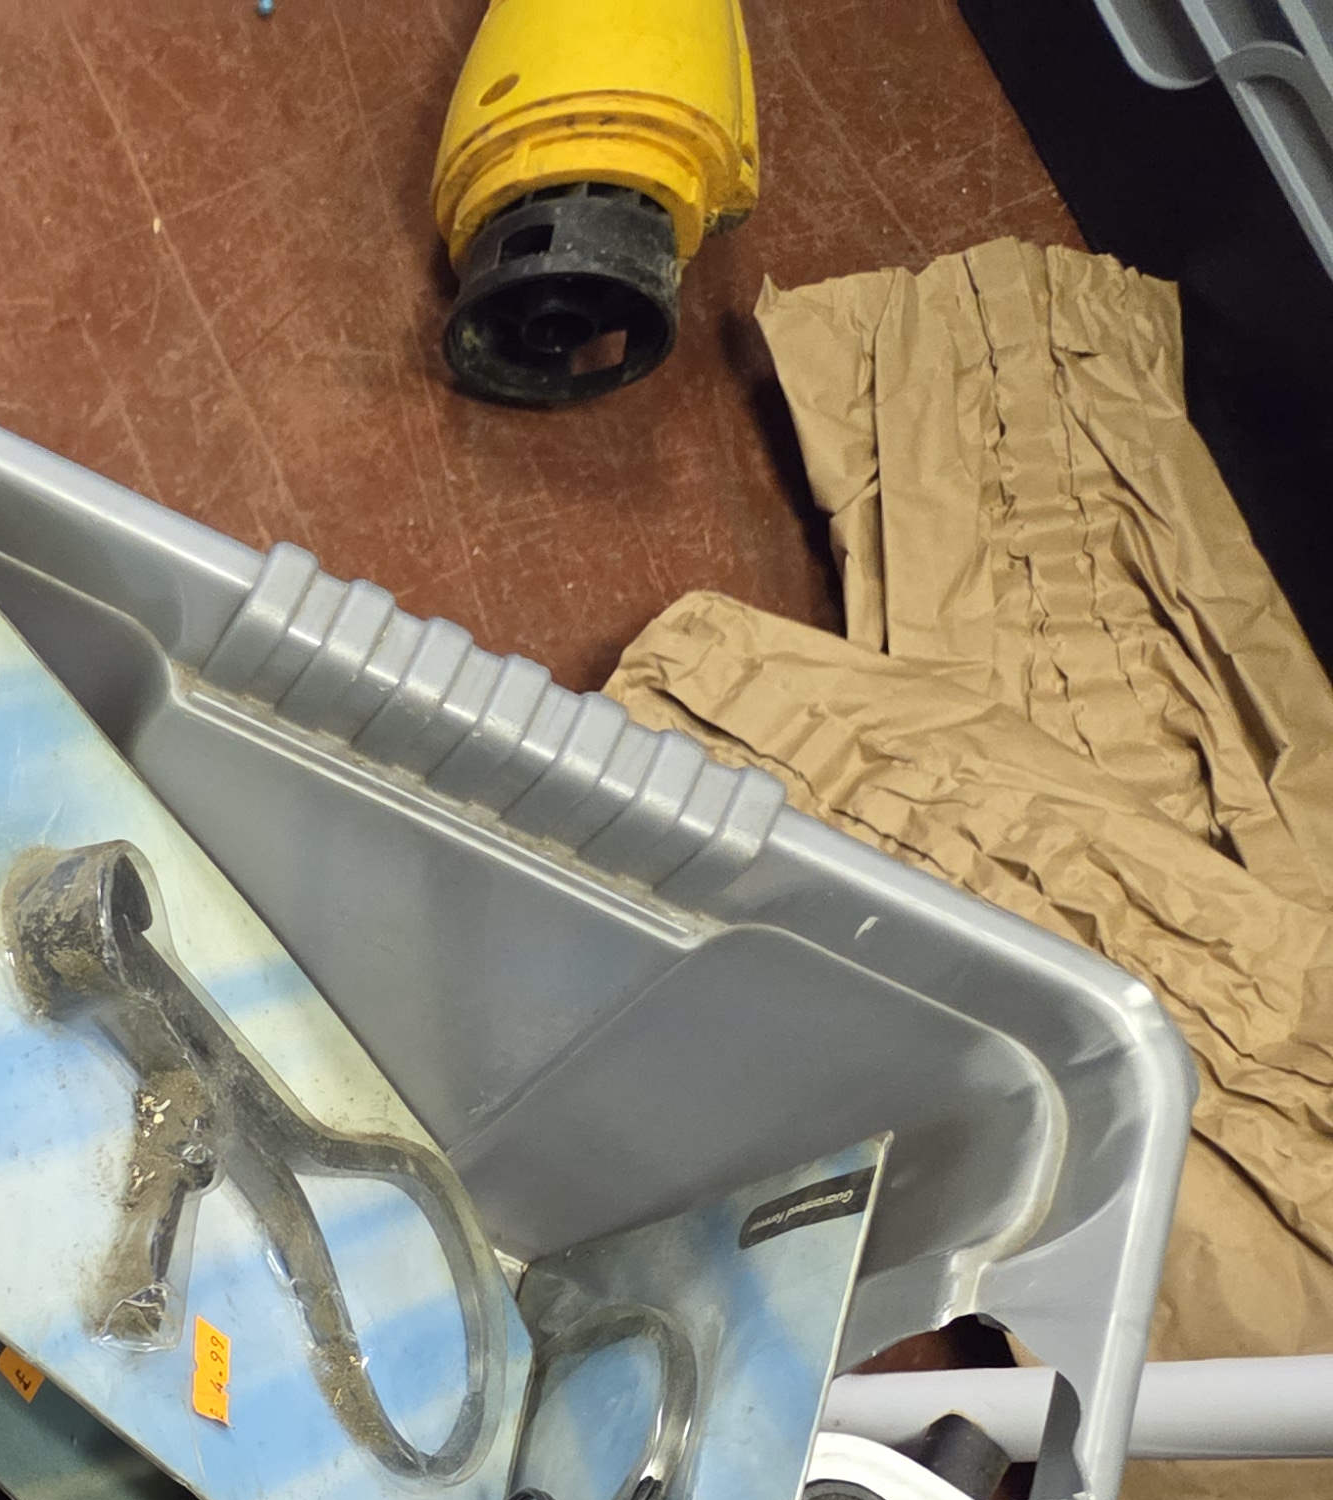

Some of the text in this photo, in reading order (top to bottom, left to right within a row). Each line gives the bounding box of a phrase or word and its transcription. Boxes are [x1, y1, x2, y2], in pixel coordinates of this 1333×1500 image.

[784, 1189, 854, 1222] Guaranteed
[15, 1368, 32, 1391] £
[210, 1335, 225, 1394] 4.99
